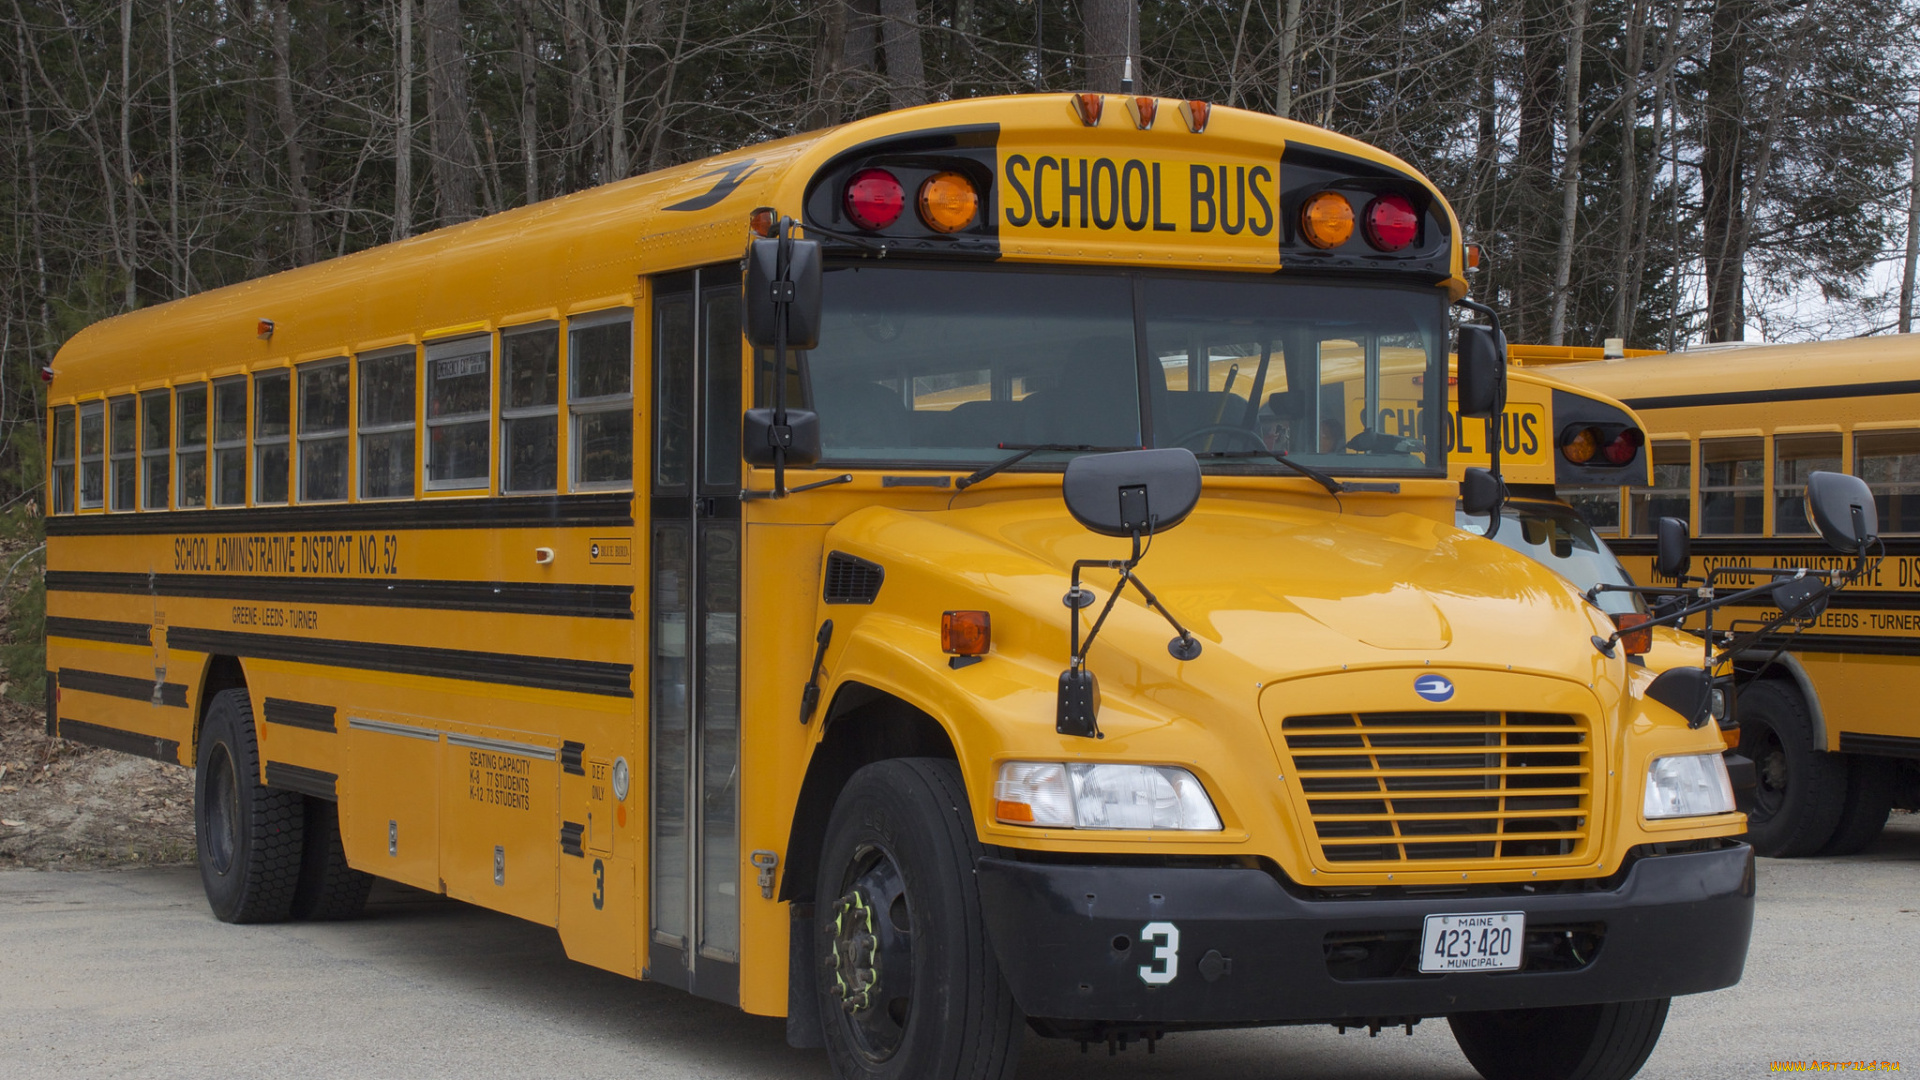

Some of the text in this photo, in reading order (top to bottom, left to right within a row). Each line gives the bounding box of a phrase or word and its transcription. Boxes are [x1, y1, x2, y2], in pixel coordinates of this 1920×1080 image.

[1005, 154, 1273, 237] SCHOOL BUS
[1360, 408, 1473, 453] CHL
[175, 534, 398, 574] SCHOOL ADMINISTRATIVE DISTRICT NO. 52
[1703, 556, 1755, 585] SCHOOL
[232, 606, 257, 625] GREENE
[262, 608, 284, 627] LEEDS
[289, 609, 318, 630] TURNER
[1819, 613, 1859, 628] LEEDS
[1870, 614, 1920, 631] TURNER
[470, 751, 530, 775] SEATING CAPACITY
[470, 769, 529, 793] K-8 77 STUDENTS
[592, 785, 604, 801] ONLY
[470, 785, 529, 811] K-12 73 STUDENTS
[593, 858, 604, 911] 3
[1458, 917, 1494, 927] MAINE
[1138, 921, 1180, 986] 3
[1447, 957, 1498, 968] MUNICIPAL
